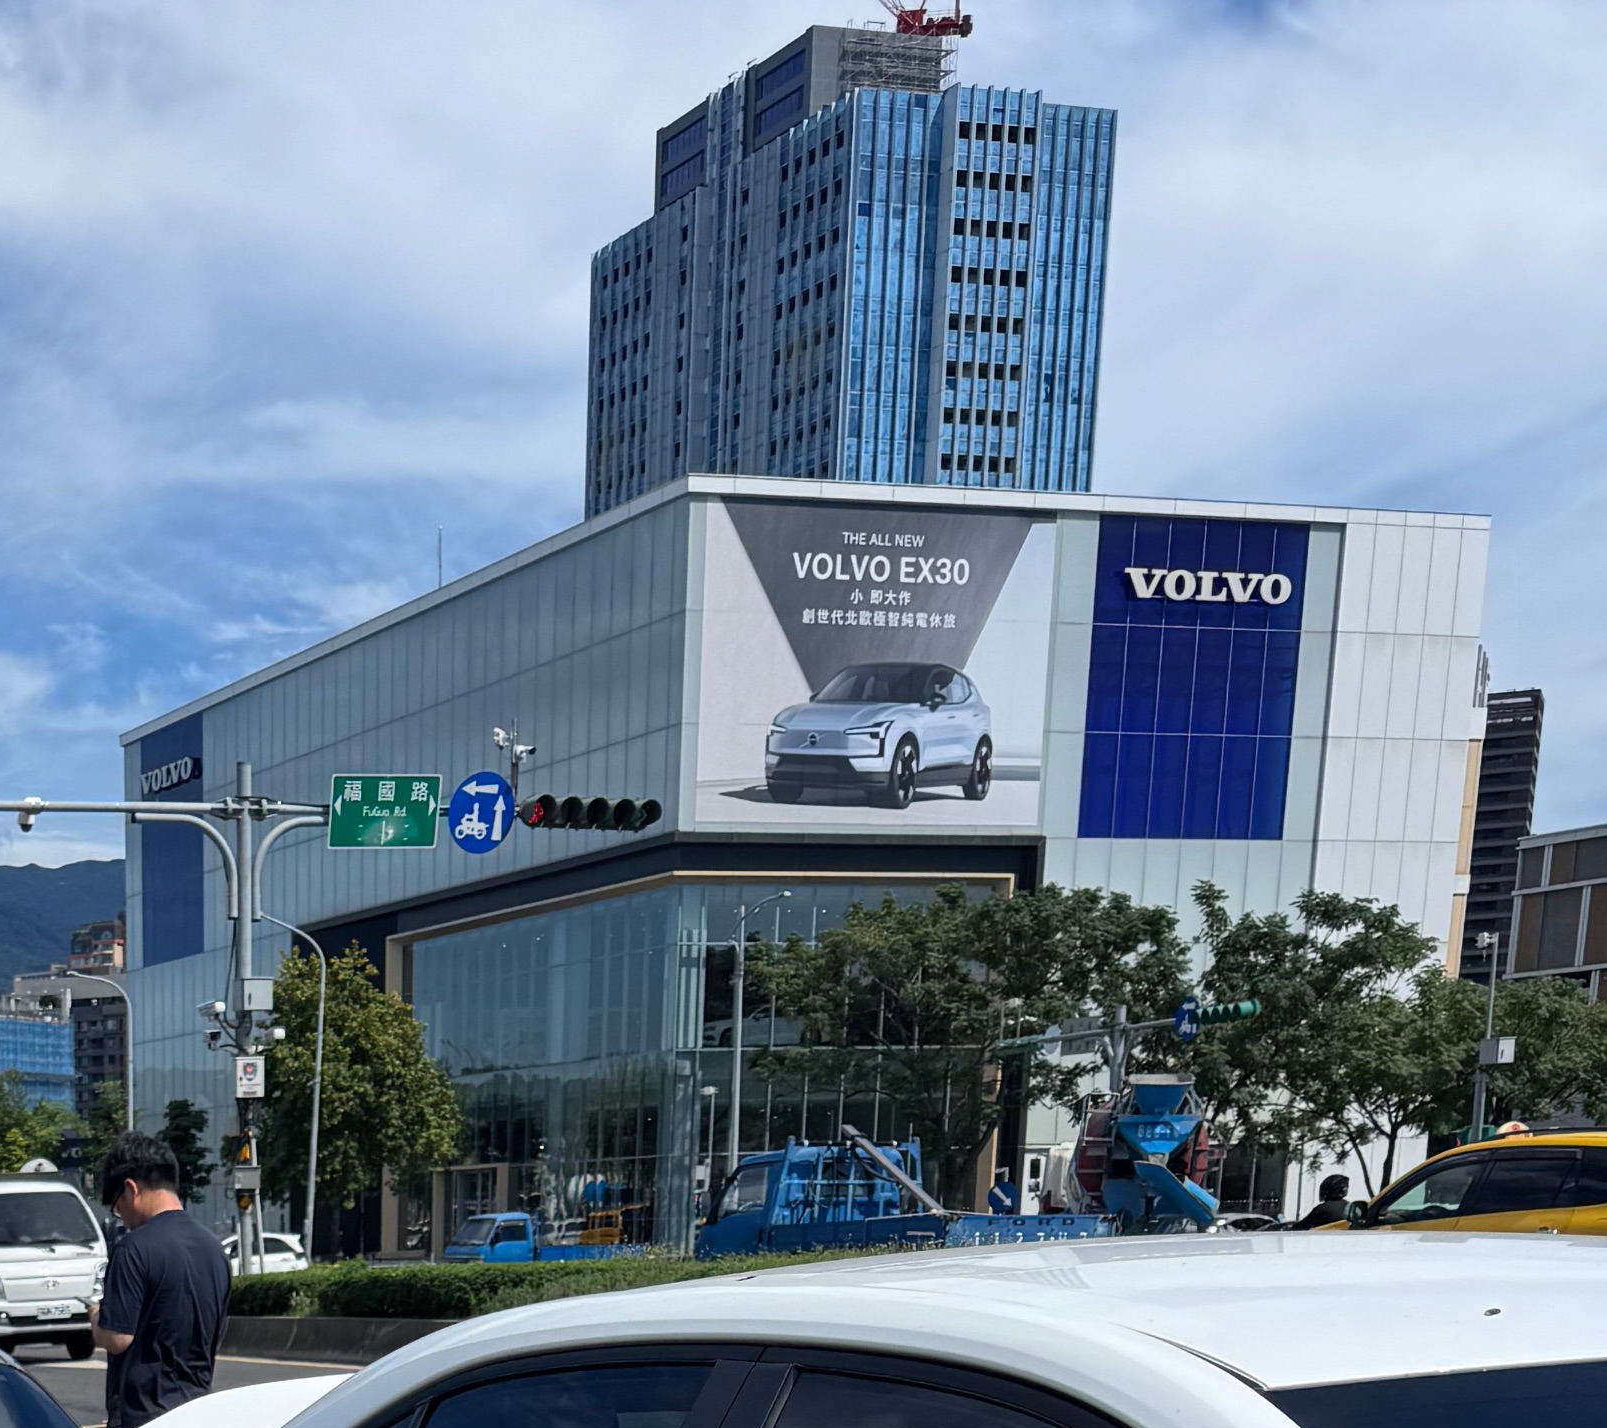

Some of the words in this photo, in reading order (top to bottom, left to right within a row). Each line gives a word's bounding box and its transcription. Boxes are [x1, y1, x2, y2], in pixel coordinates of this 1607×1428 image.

[842, 531, 867, 546] THE
[869, 533, 892, 547] ALL
[894, 534, 925, 548] NEW
[792, 551, 891, 583] VOLVO
[899, 556, 970, 586] EX30
[1124, 567, 1293, 605] VOLVO
[141, 756, 192, 795] VOLVO
[343, 780, 429, 802] 福國路
[988, 1217, 1075, 1226] FORD
